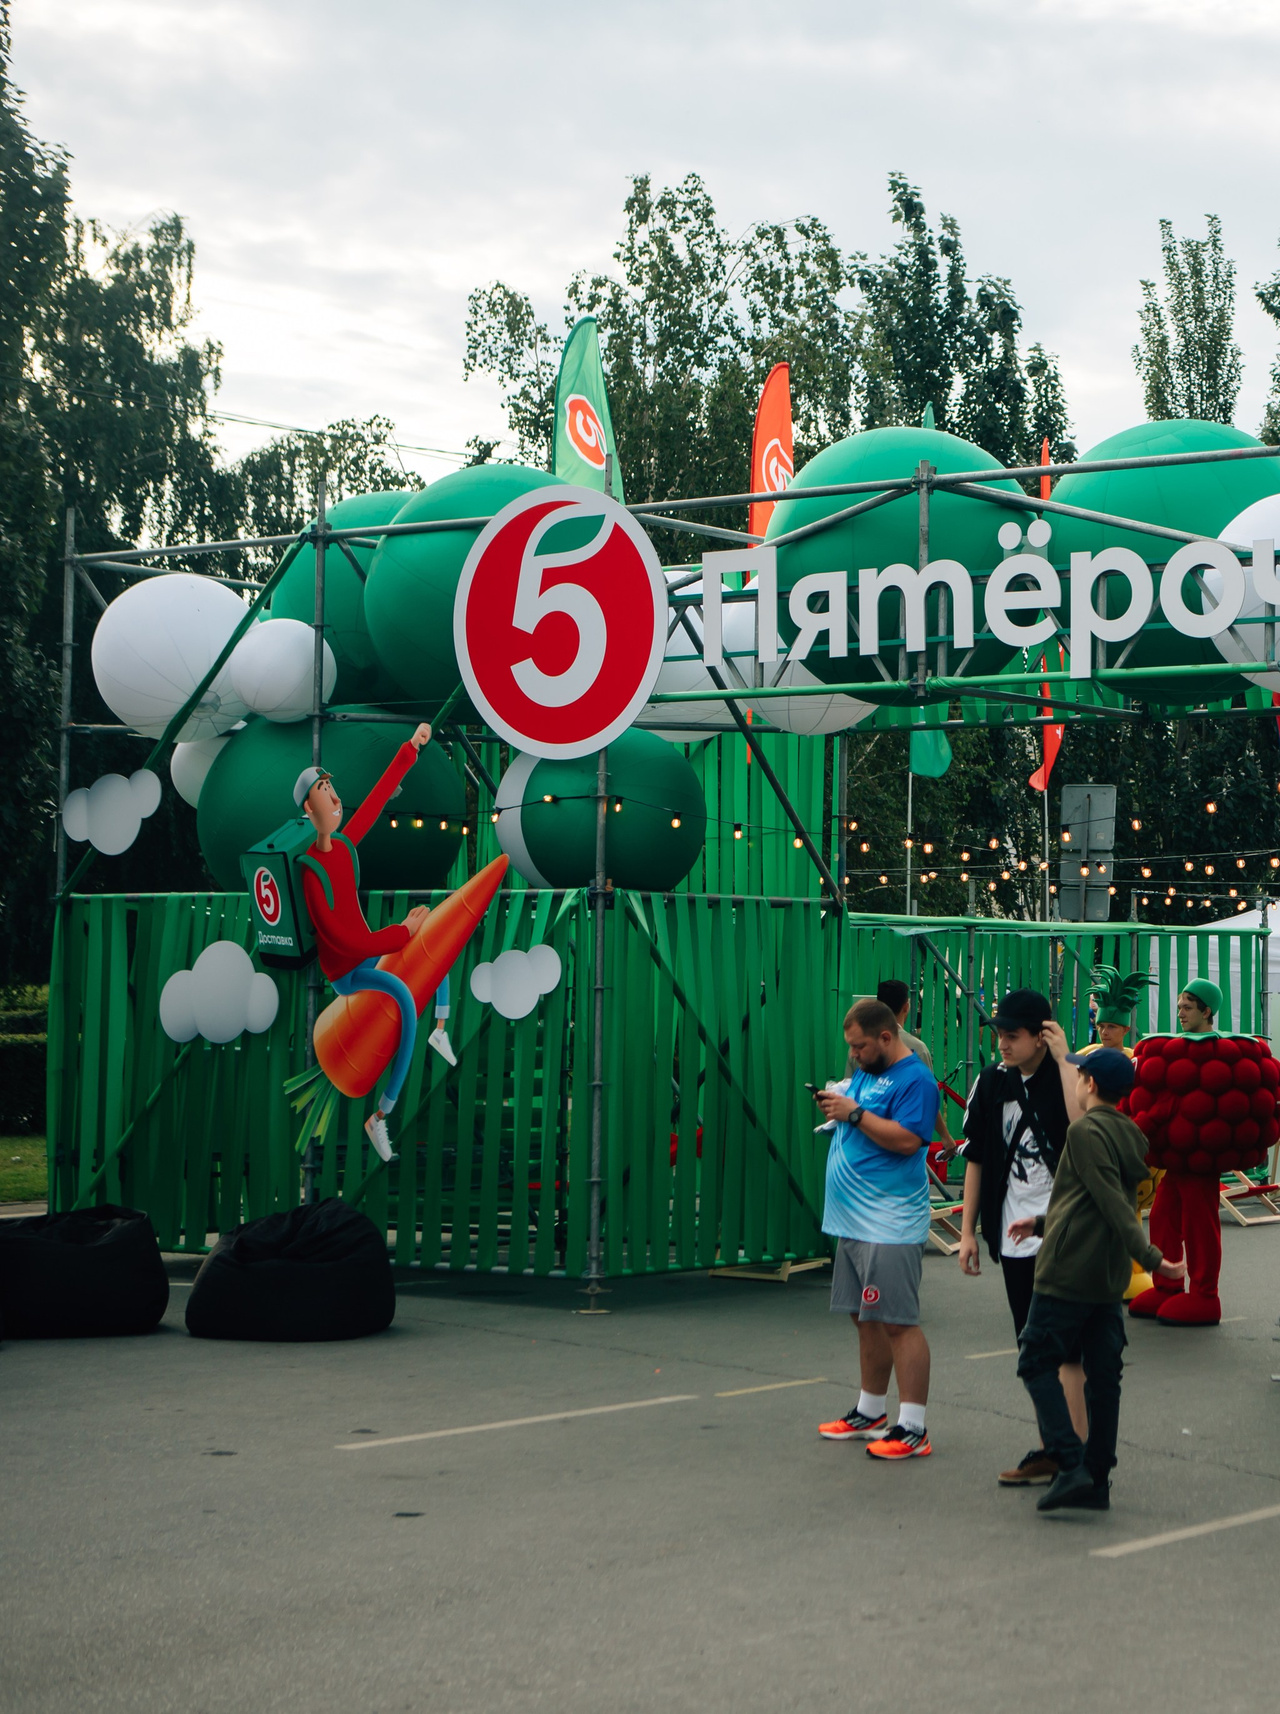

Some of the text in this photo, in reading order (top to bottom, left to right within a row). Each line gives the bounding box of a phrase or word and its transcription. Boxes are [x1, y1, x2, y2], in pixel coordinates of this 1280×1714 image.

[510, 502, 618, 708] 5
[260, 872, 276, 915] 5
[257, 930, 294, 946] Доставка
